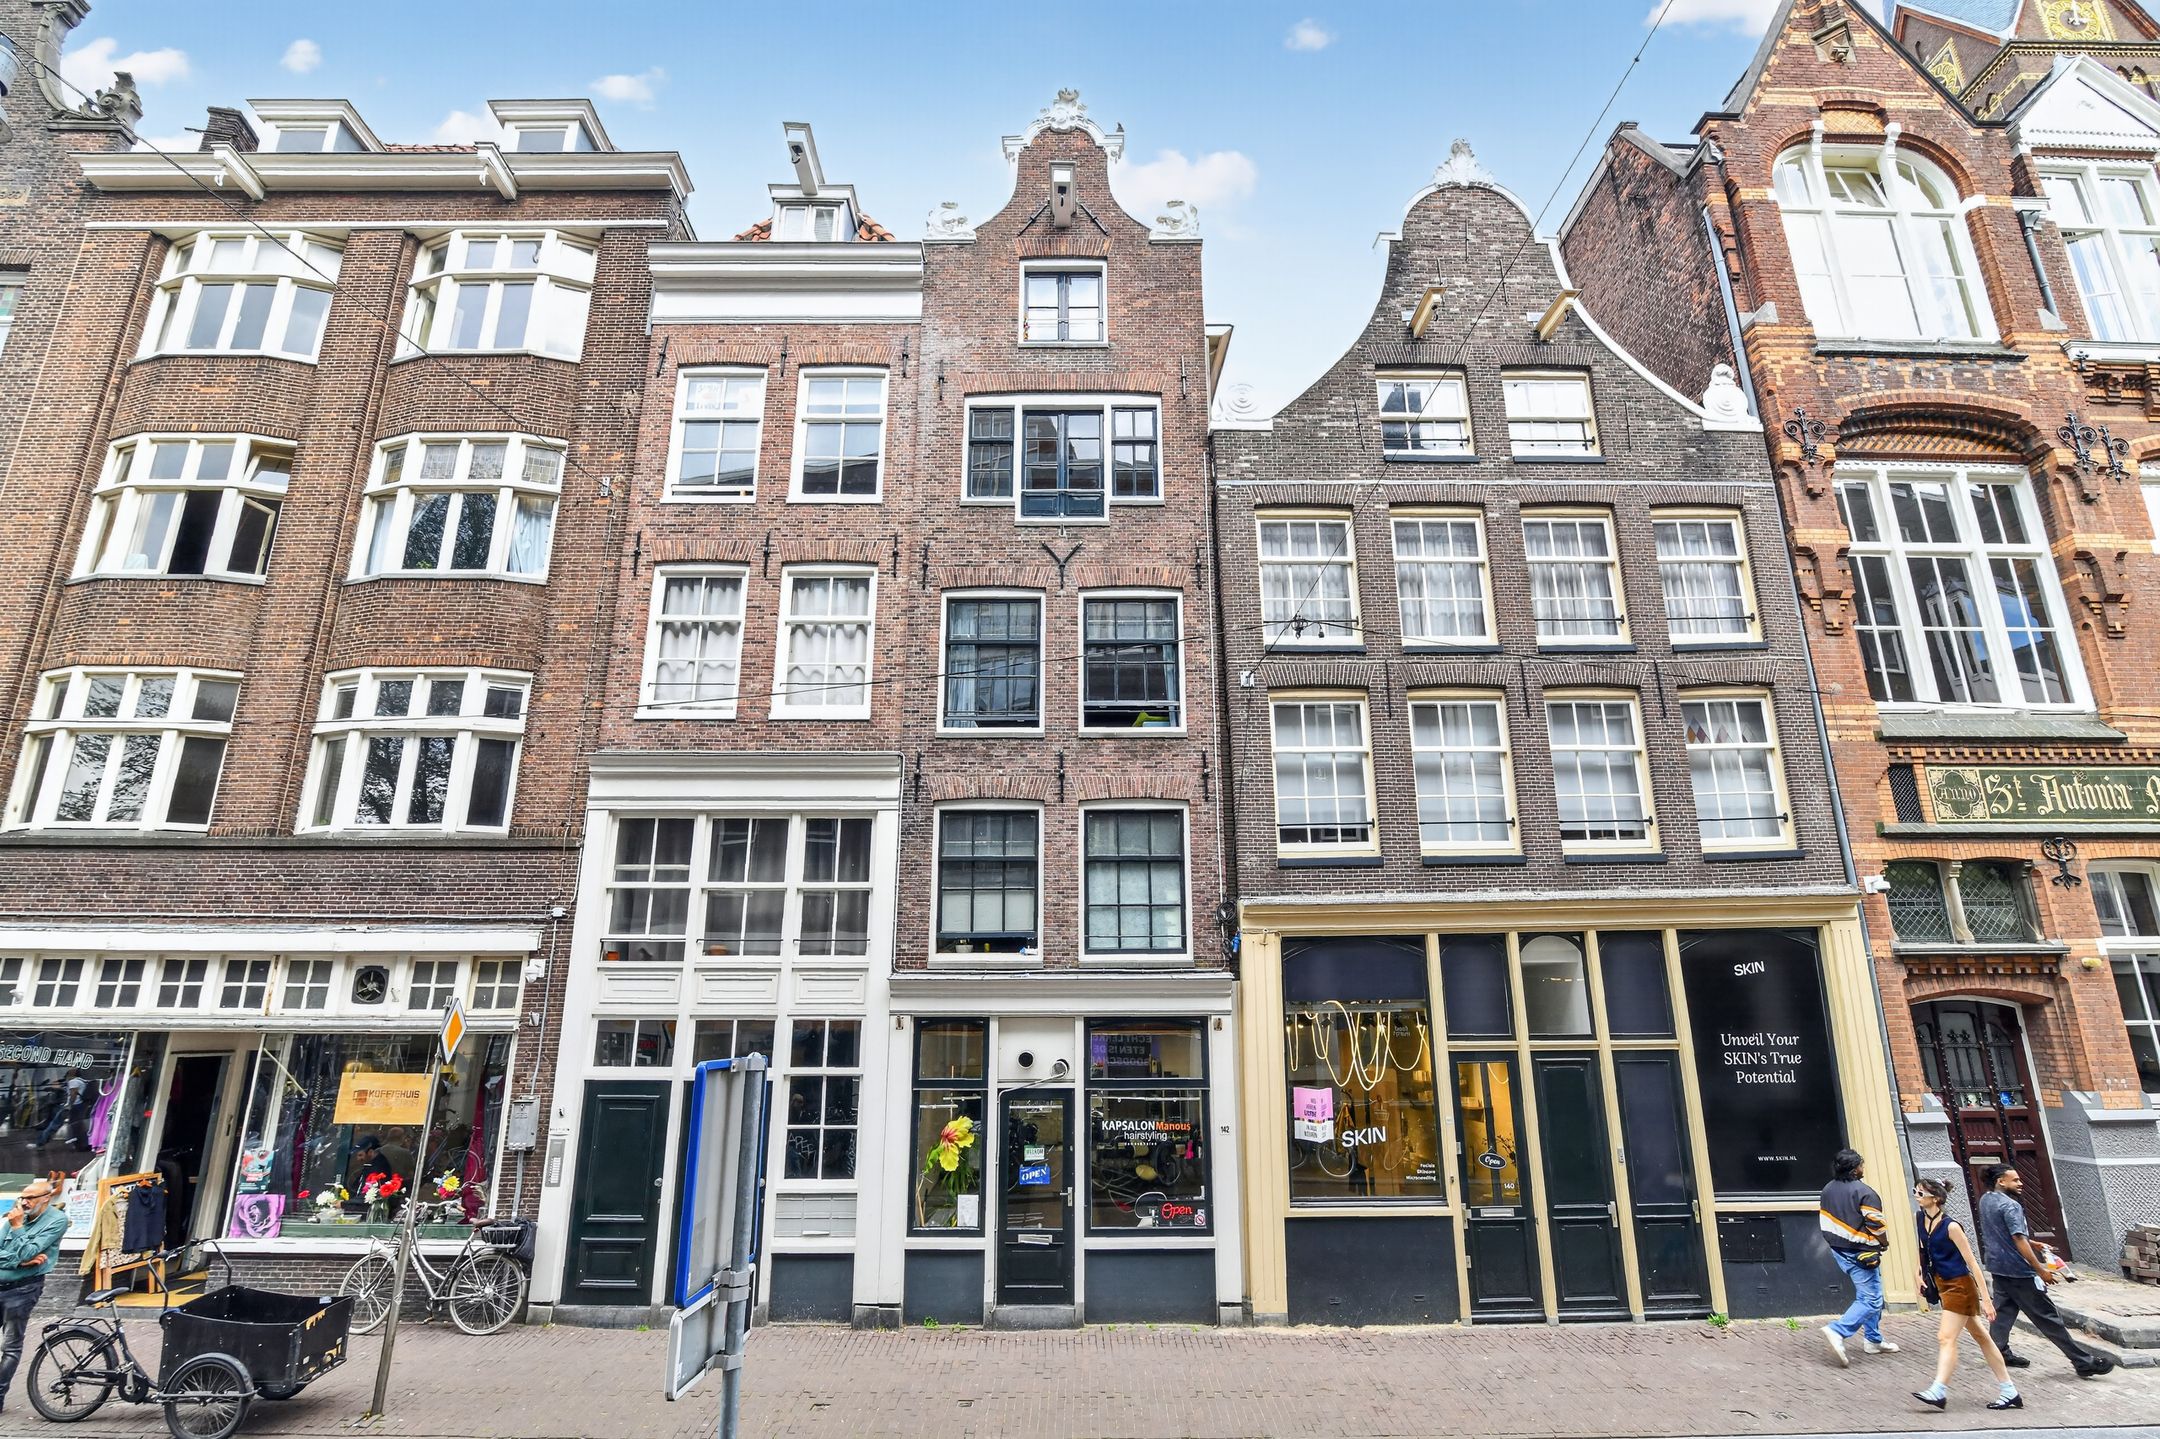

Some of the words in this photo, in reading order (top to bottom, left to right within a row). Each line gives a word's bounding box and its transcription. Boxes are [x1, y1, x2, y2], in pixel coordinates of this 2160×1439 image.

[1938, 787, 1978, 801] Anno
[1733, 960, 1765, 977] SKIN
[1720, 1033, 1765, 1046] Unveil
[1766, 1033, 1800, 1046] Your
[53, 1049, 94, 1070] HAND
[1723, 1052, 1768, 1065] SKIN's
[1769, 1052, 1802, 1065] True
[1735, 1070, 1797, 1084] Potential
[368, 1089, 420, 1099] KOFFIEHUIS
[1101, 1120, 1156, 1131] KAPSALON
[1220, 1125, 1230, 1134] 142
[1123, 1131, 1168, 1142] hairstyling
[1341, 1125, 1387, 1148] SKIN
[1484, 1156, 1501, 1166] Open
[1021, 1168, 1048, 1181] OPEN
[1162, 1202, 1193, 1220] Open
